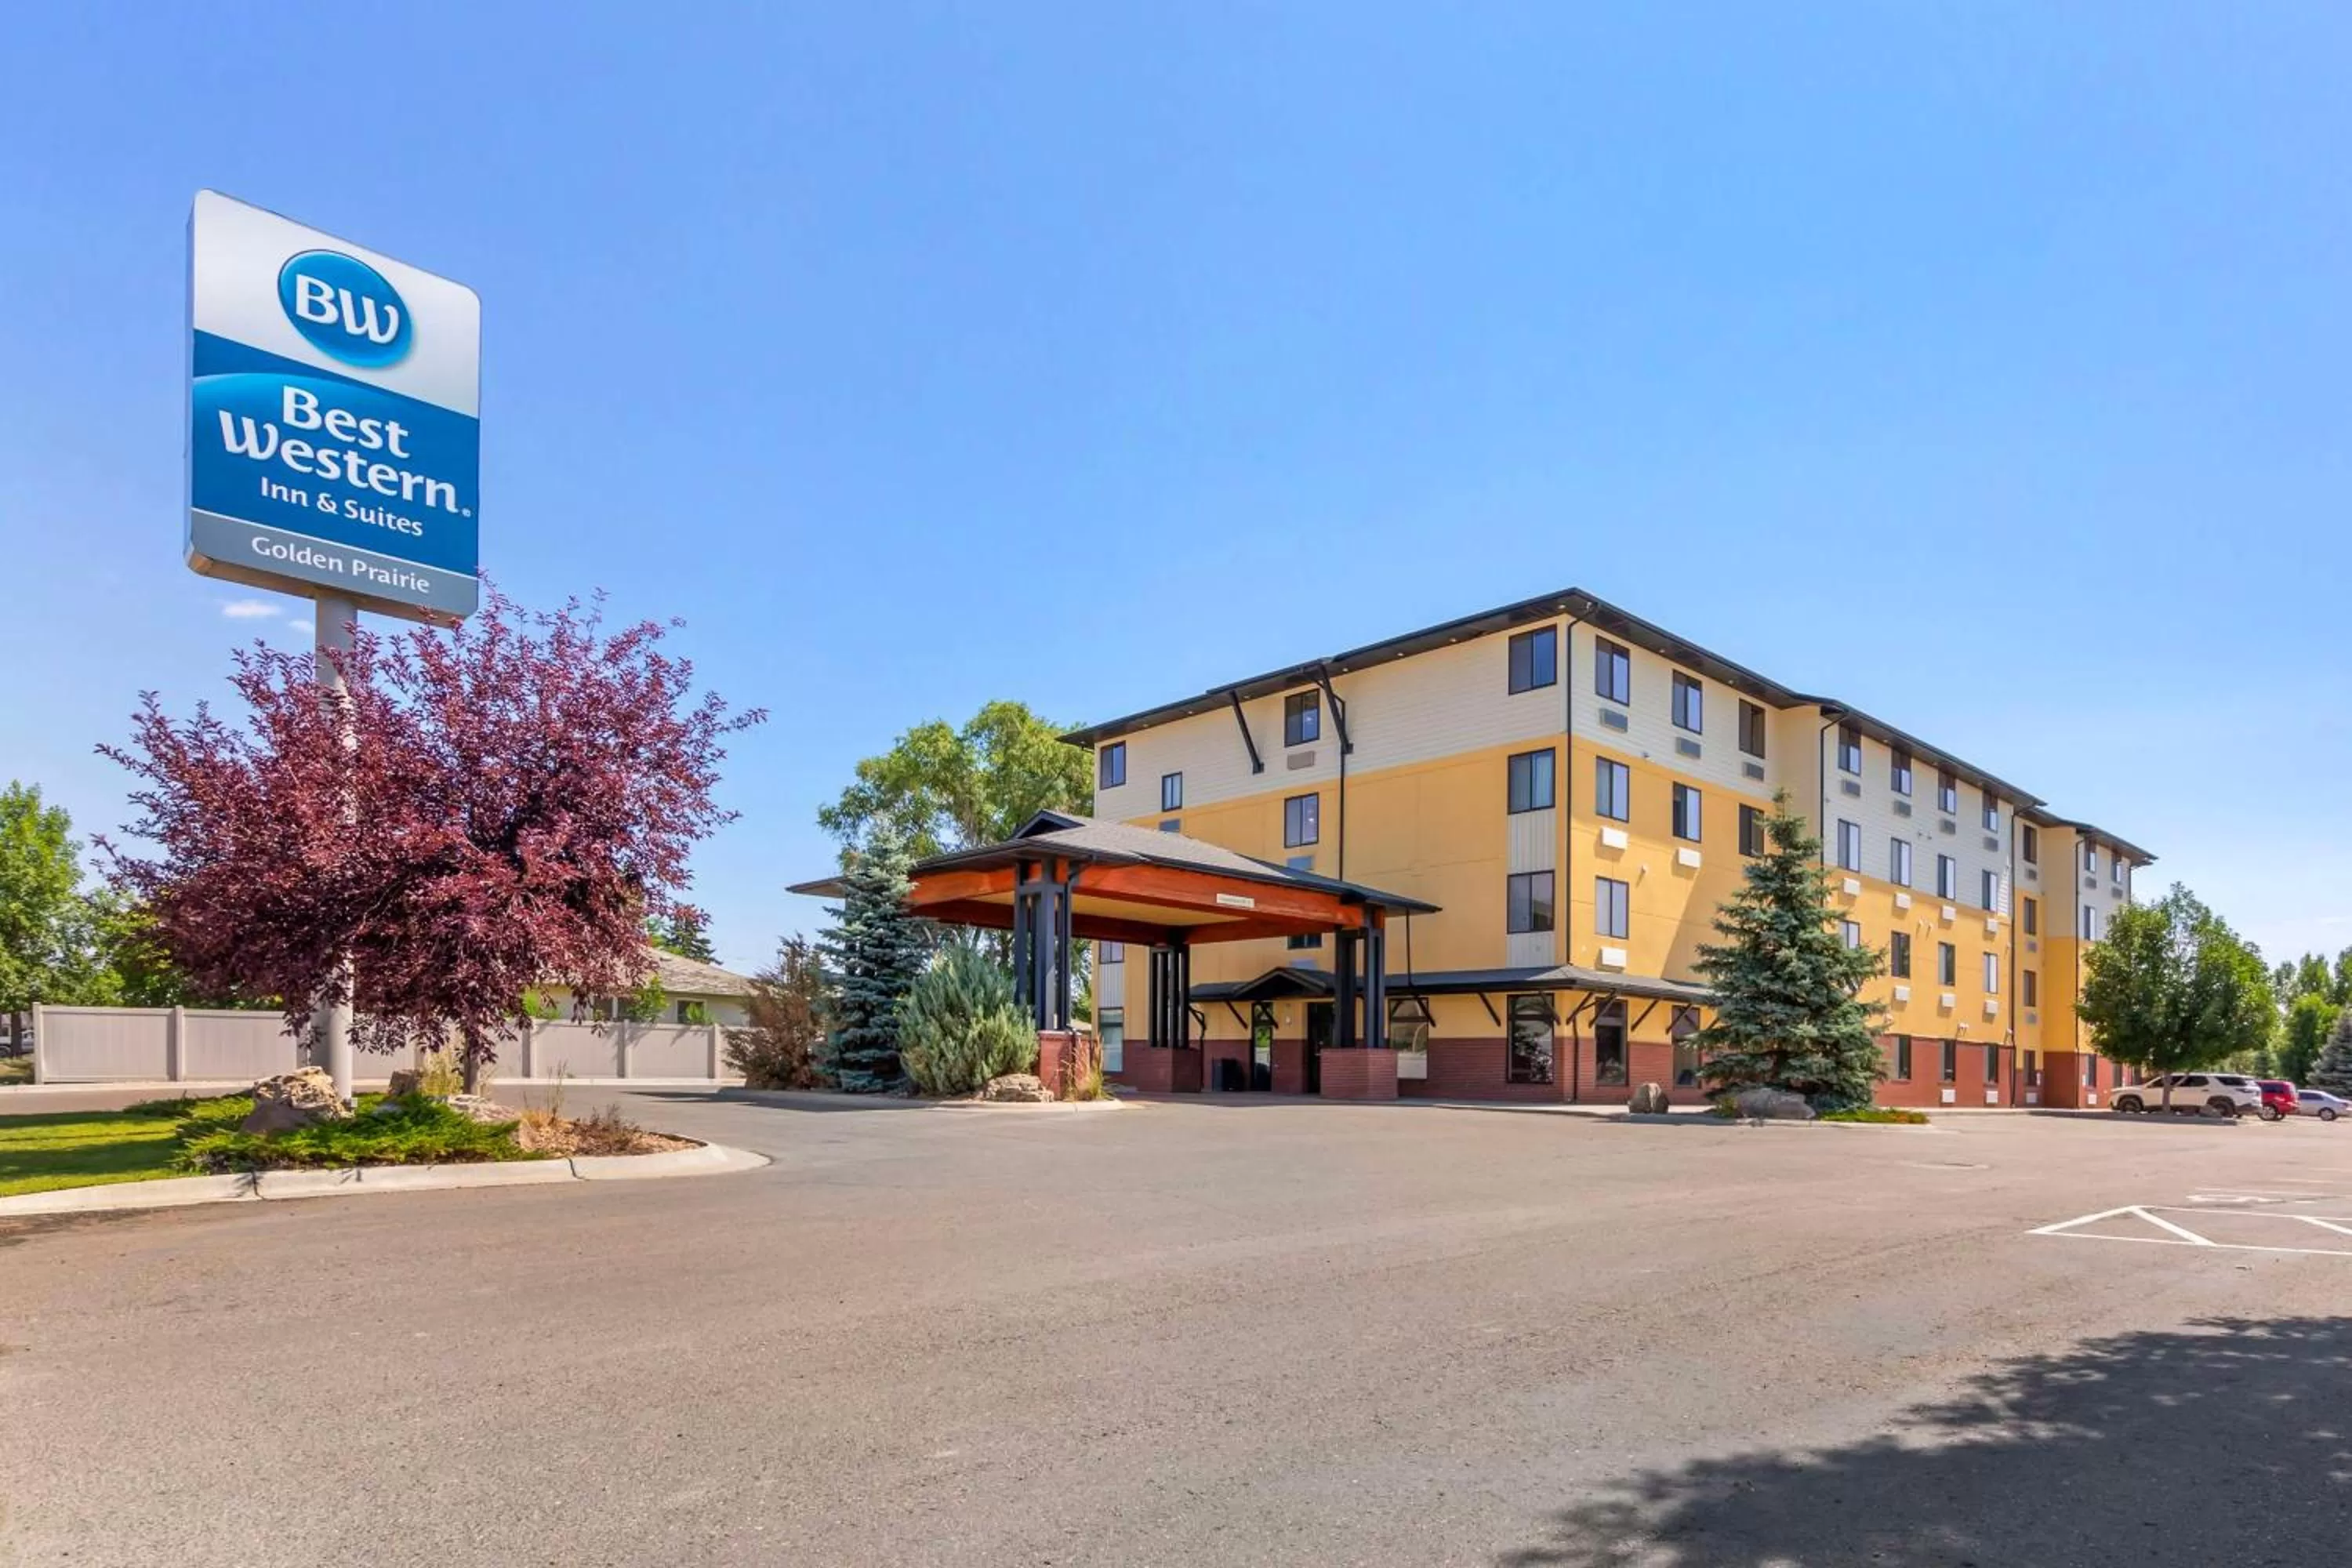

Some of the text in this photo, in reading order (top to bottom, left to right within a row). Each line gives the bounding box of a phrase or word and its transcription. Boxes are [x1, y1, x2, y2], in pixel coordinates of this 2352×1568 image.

[296, 274, 400, 345] BW
[283, 385, 410, 459] Best
[261, 475, 423, 538] Inn & Suites
[251, 536, 430, 593] Golden Prairie
